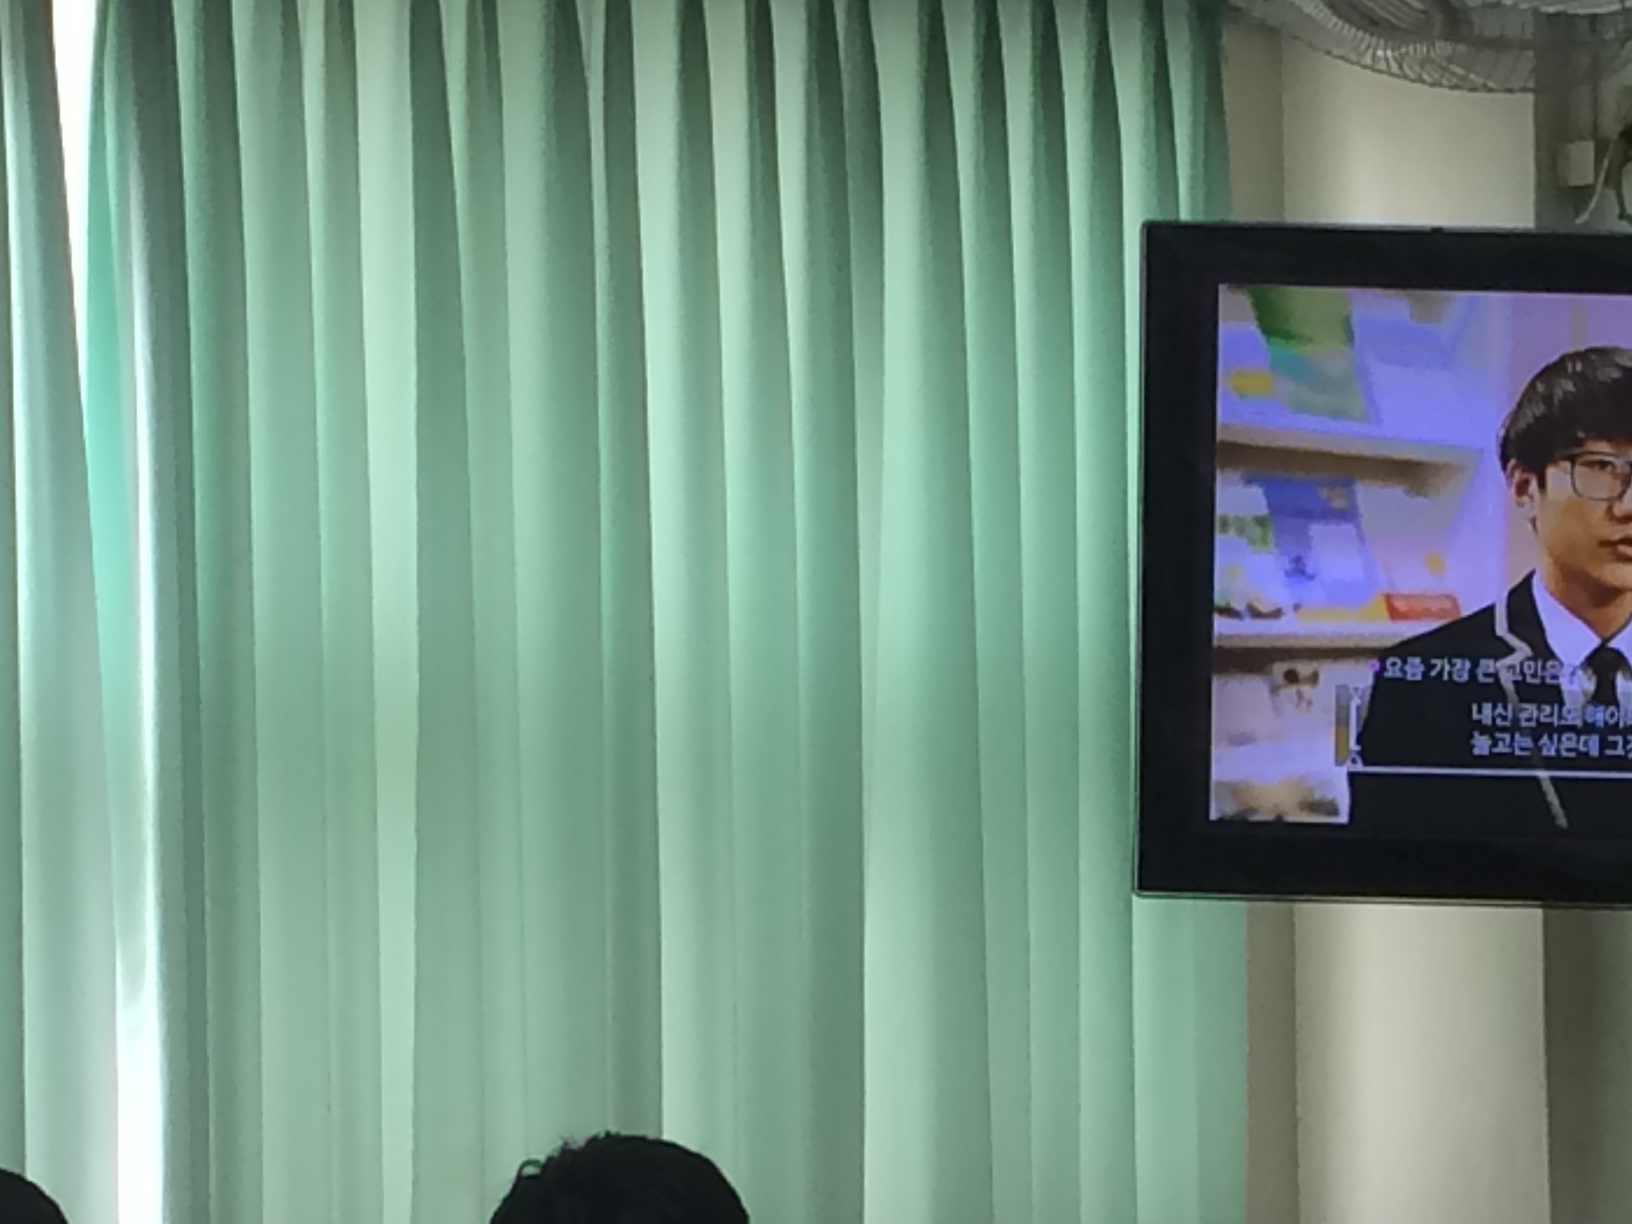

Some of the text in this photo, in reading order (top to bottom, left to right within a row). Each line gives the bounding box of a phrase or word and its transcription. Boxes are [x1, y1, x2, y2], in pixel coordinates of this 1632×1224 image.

[1384, 656, 1425, 682] 요즘
[1430, 657, 1470, 682] 가장
[1472, 703, 1512, 726] 내신
[1538, 732, 1599, 758] 싶은데
